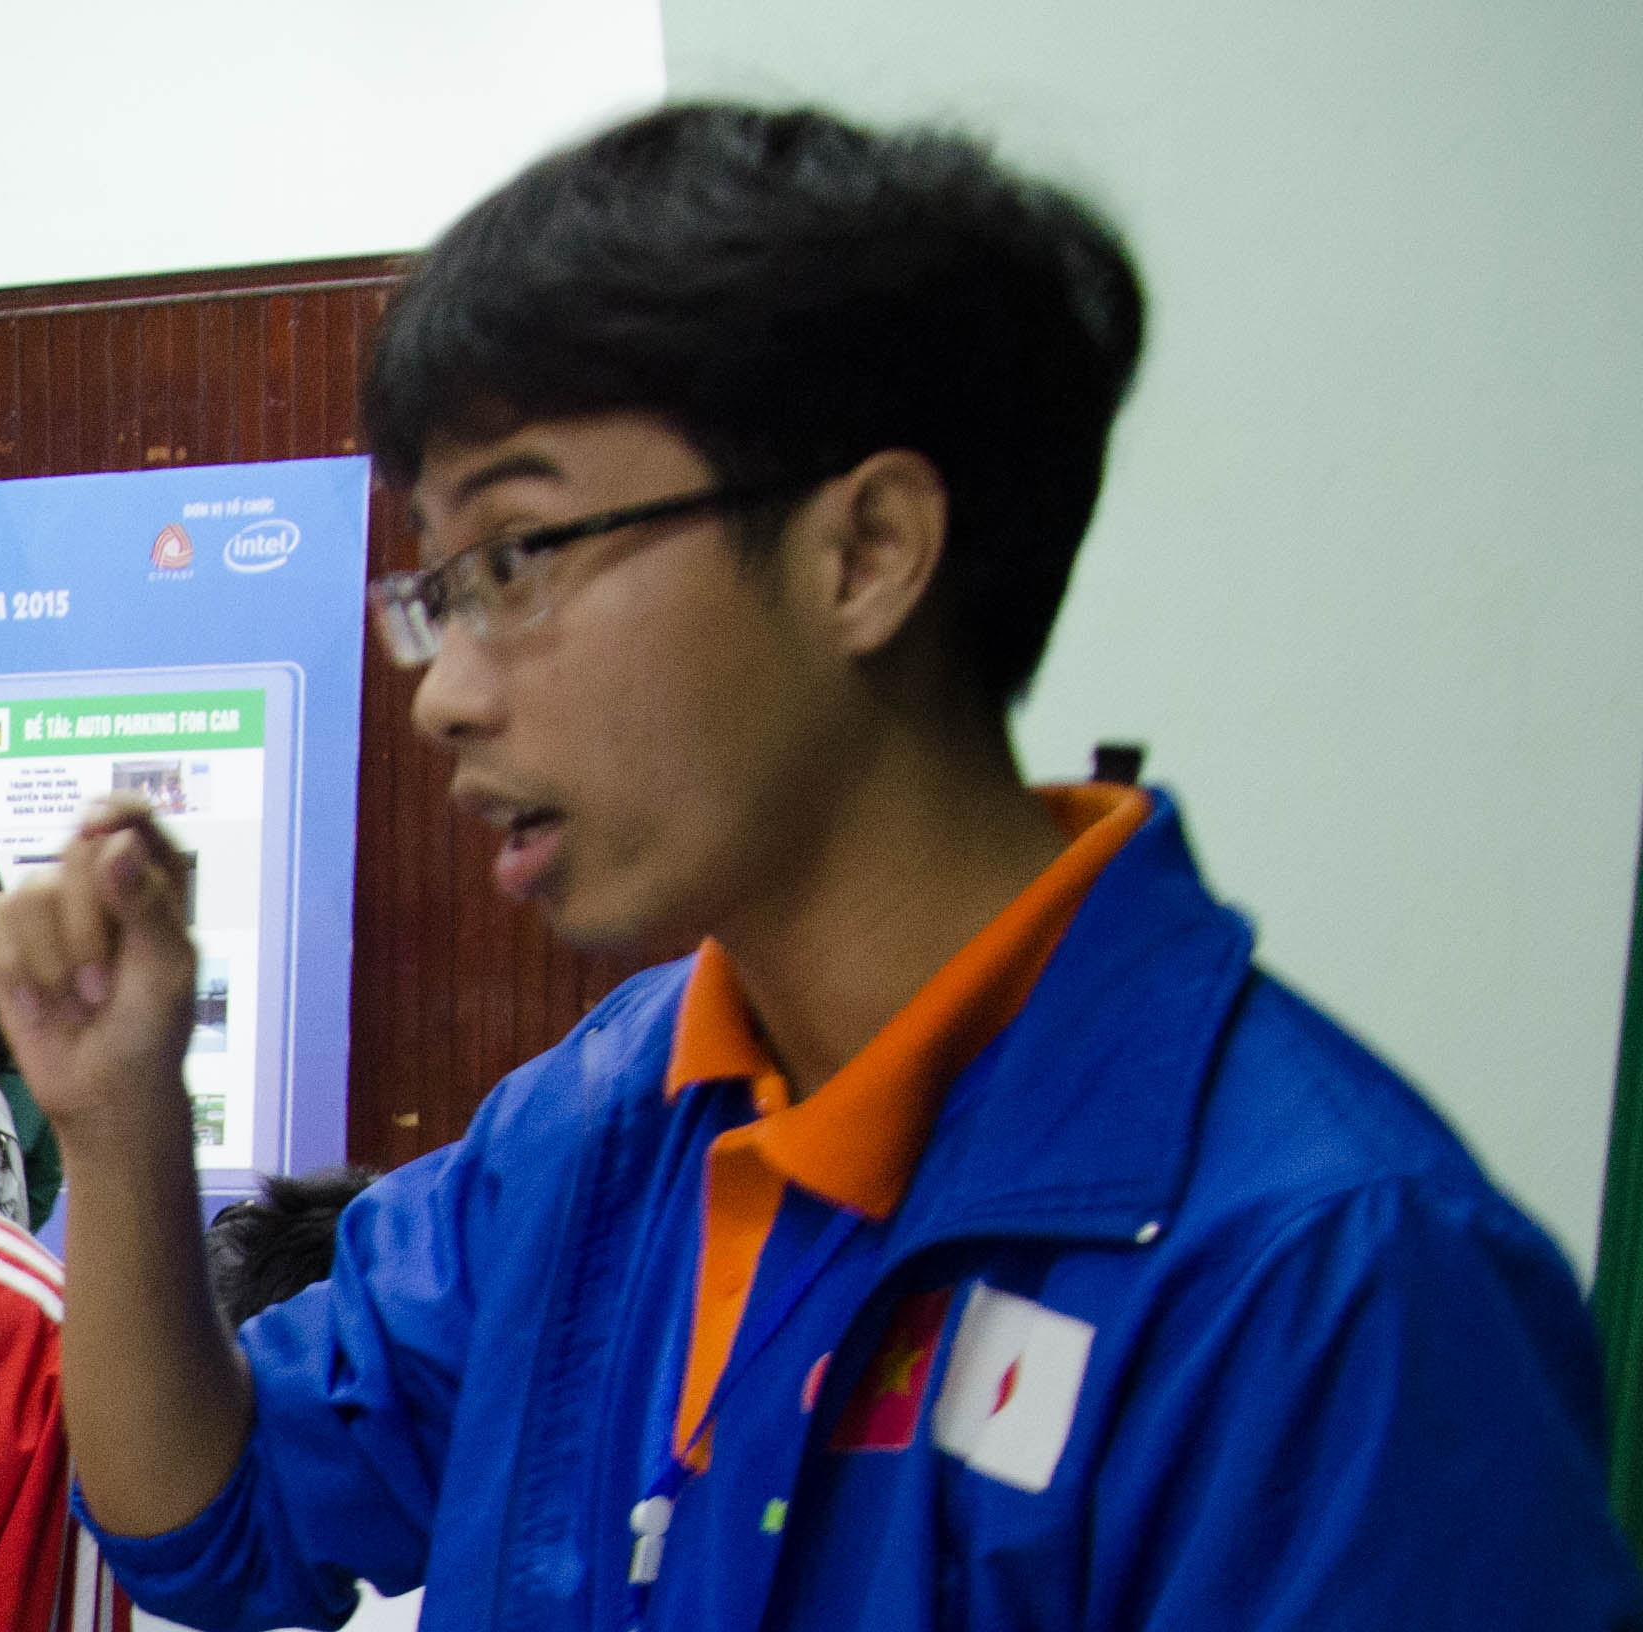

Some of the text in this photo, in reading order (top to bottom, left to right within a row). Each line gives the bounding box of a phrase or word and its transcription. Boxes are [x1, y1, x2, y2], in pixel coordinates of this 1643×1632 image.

[234, 530, 288, 558] intel
[12, 588, 71, 621] 2015
[75, 713, 113, 739] AUTO
[114, 710, 177, 737] PARKING
[178, 709, 208, 734] FOR
[209, 708, 242, 733] CAR
